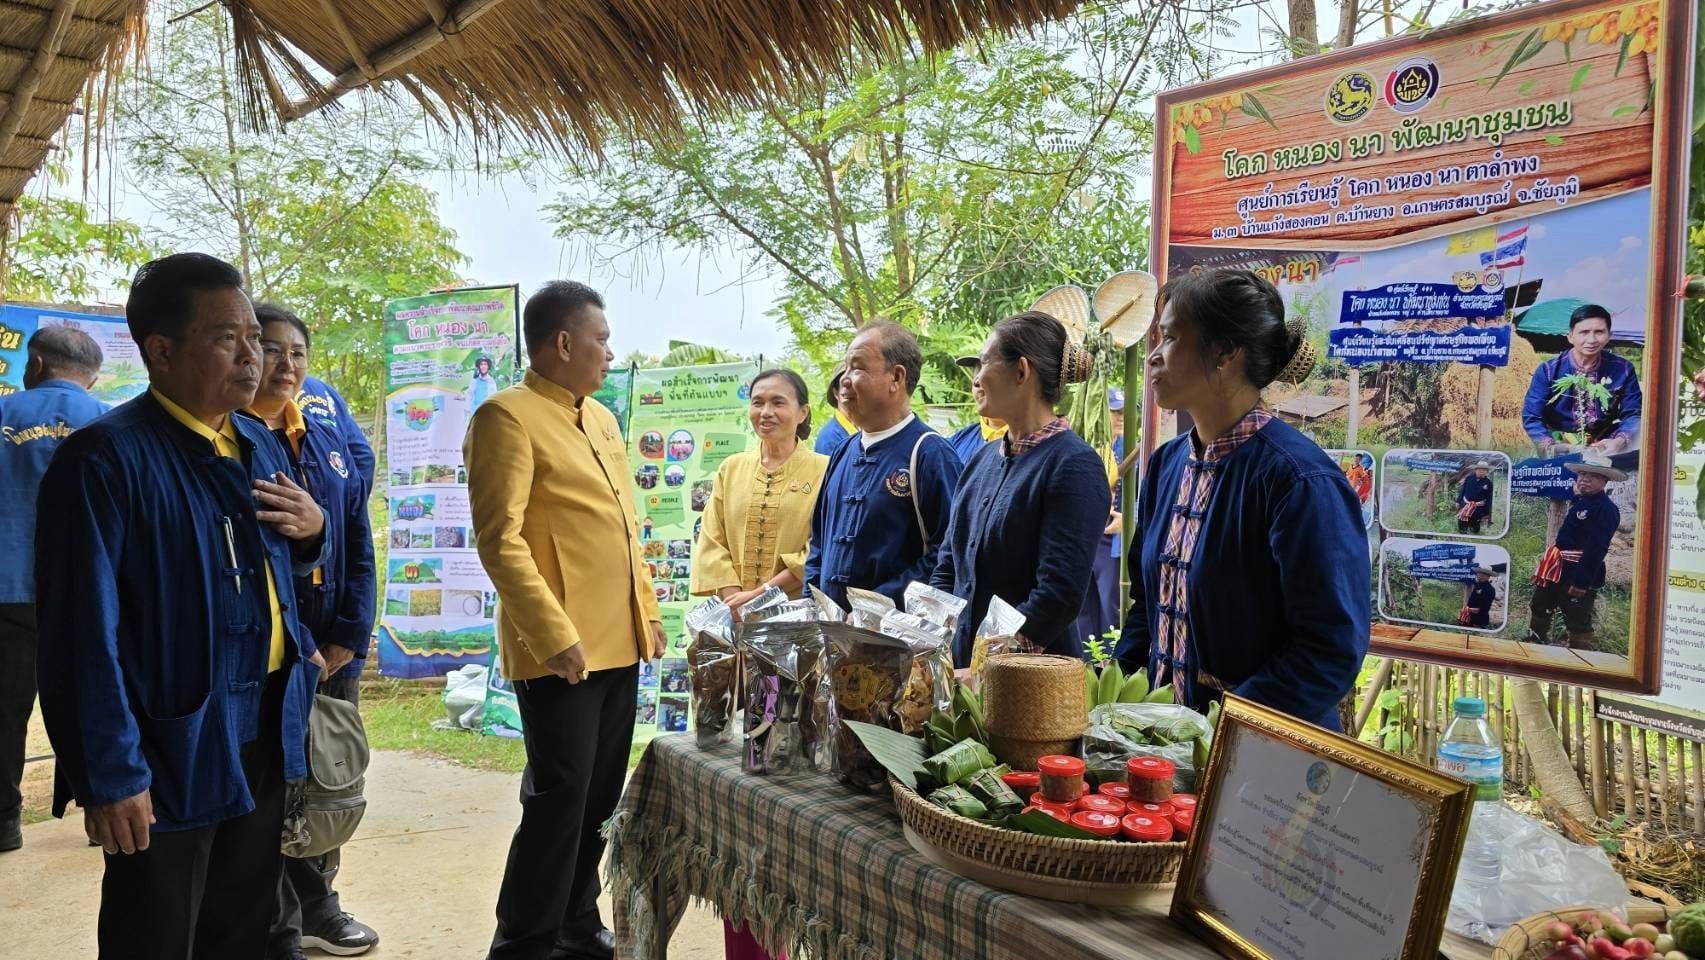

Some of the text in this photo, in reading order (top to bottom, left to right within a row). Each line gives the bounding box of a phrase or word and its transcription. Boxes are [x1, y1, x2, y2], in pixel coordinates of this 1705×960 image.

[1224, 149, 1266, 176] โคก
[1274, 140, 1340, 169] หนอง
[1349, 133, 1382, 156] นา
[1391, 101, 1569, 149] พัฒนาชุมชน
[1238, 152, 1537, 218] ศูนย์การเรียนรู้ โคก หนอง นา ตาลำพง
[1242, 214, 1330, 236] บ้านแก้งสองคอน
[1336, 205, 1394, 224] ต.บ้านยาง
[1402, 182, 1511, 216] อ.เกษตรสมบูรณ์
[1517, 178, 1578, 204] จ.ชัยภูมิ
[1287, 260, 1320, 284] นา
